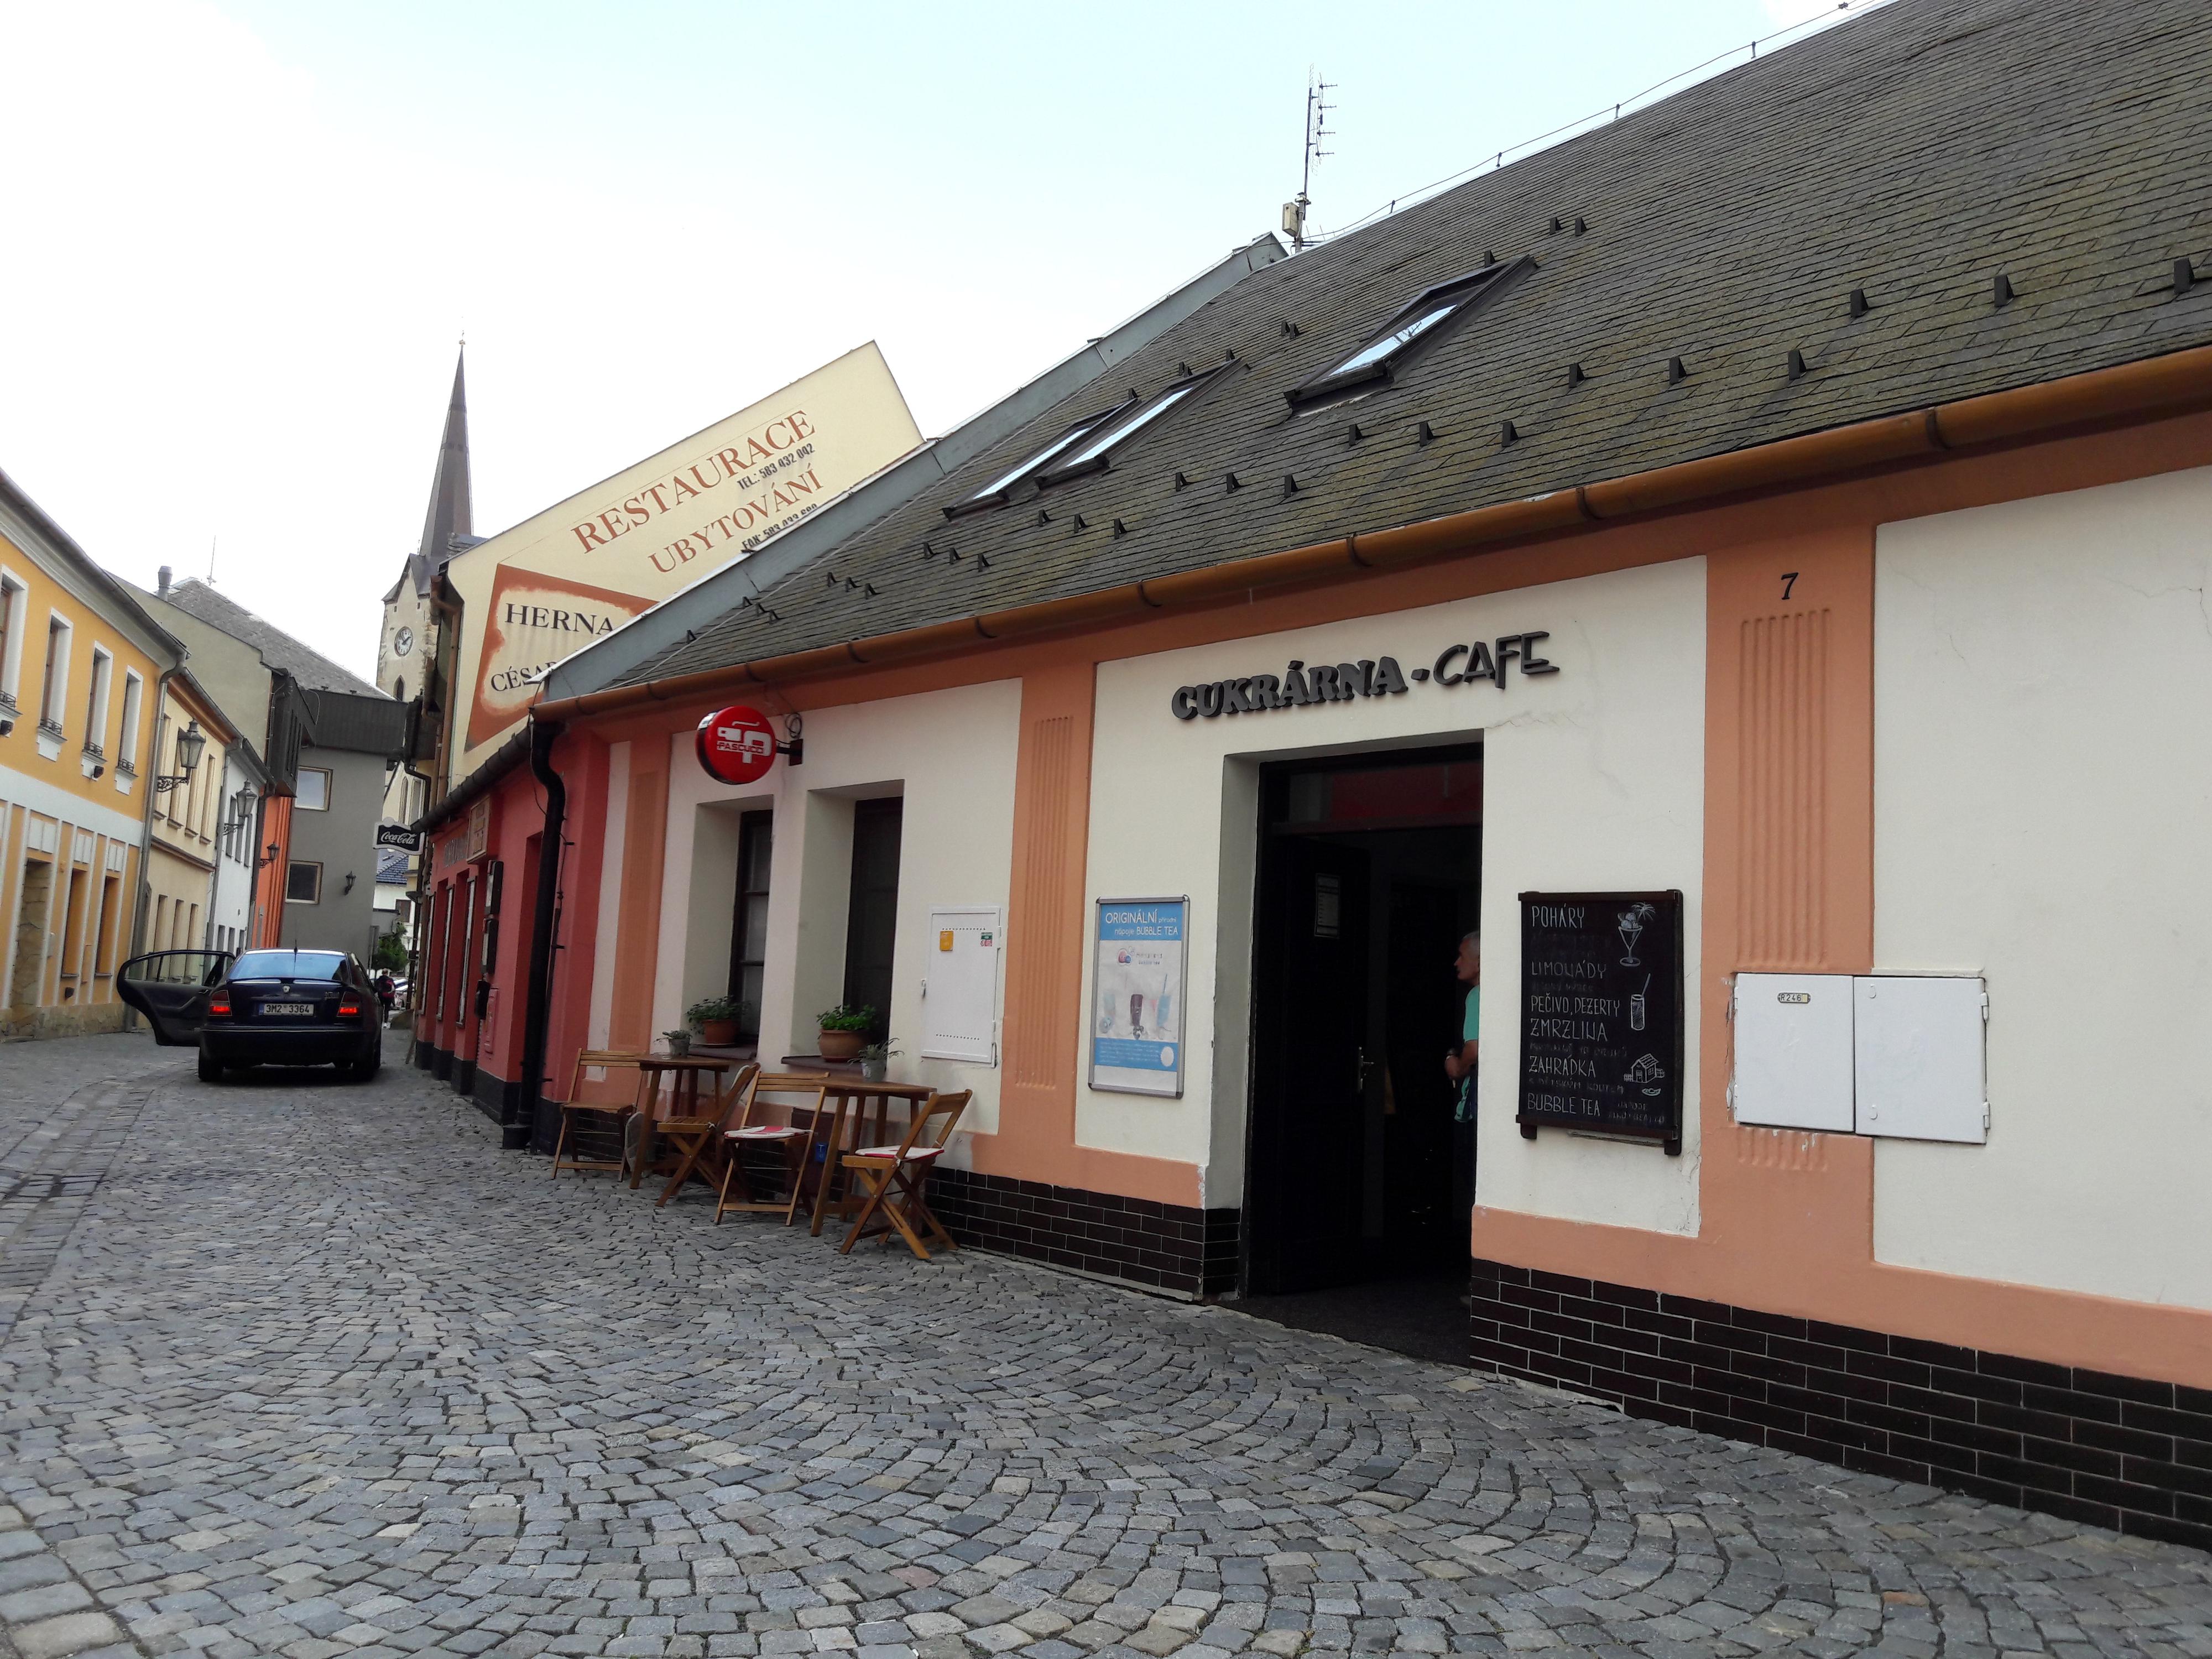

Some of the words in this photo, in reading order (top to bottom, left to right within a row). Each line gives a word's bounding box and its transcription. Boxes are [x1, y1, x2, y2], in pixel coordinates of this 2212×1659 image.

[570, 410, 816, 554] RESTAURACE
[759, 462, 778, 479] 583
[648, 462, 824, 573] UBYTOVÁNÍ
[1781, 572, 1799, 601] 7
[504, 603, 614, 635] HERNA
[1172, 656, 1408, 720] CUKRÁRNA
[1433, 631, 1560, 690] CAFE
[1105, 909, 1159, 924] ORIGINÁLNÍ
[1531, 903, 1585, 929] POHÁRY
[1136, 926, 1162, 936] BUBBLE
[1164, 926, 1178, 936] TEA
[266, 1004, 282, 1013] 3M2
[289, 1004, 310, 1013] 3364
[1574, 997, 1621, 1018] DEZERTY
[1528, 1053, 1597, 1078] ZAHRÁDKA
[1527, 1092, 1577, 1114] BUBBLE
[1580, 1098, 1601, 1117] TEA
